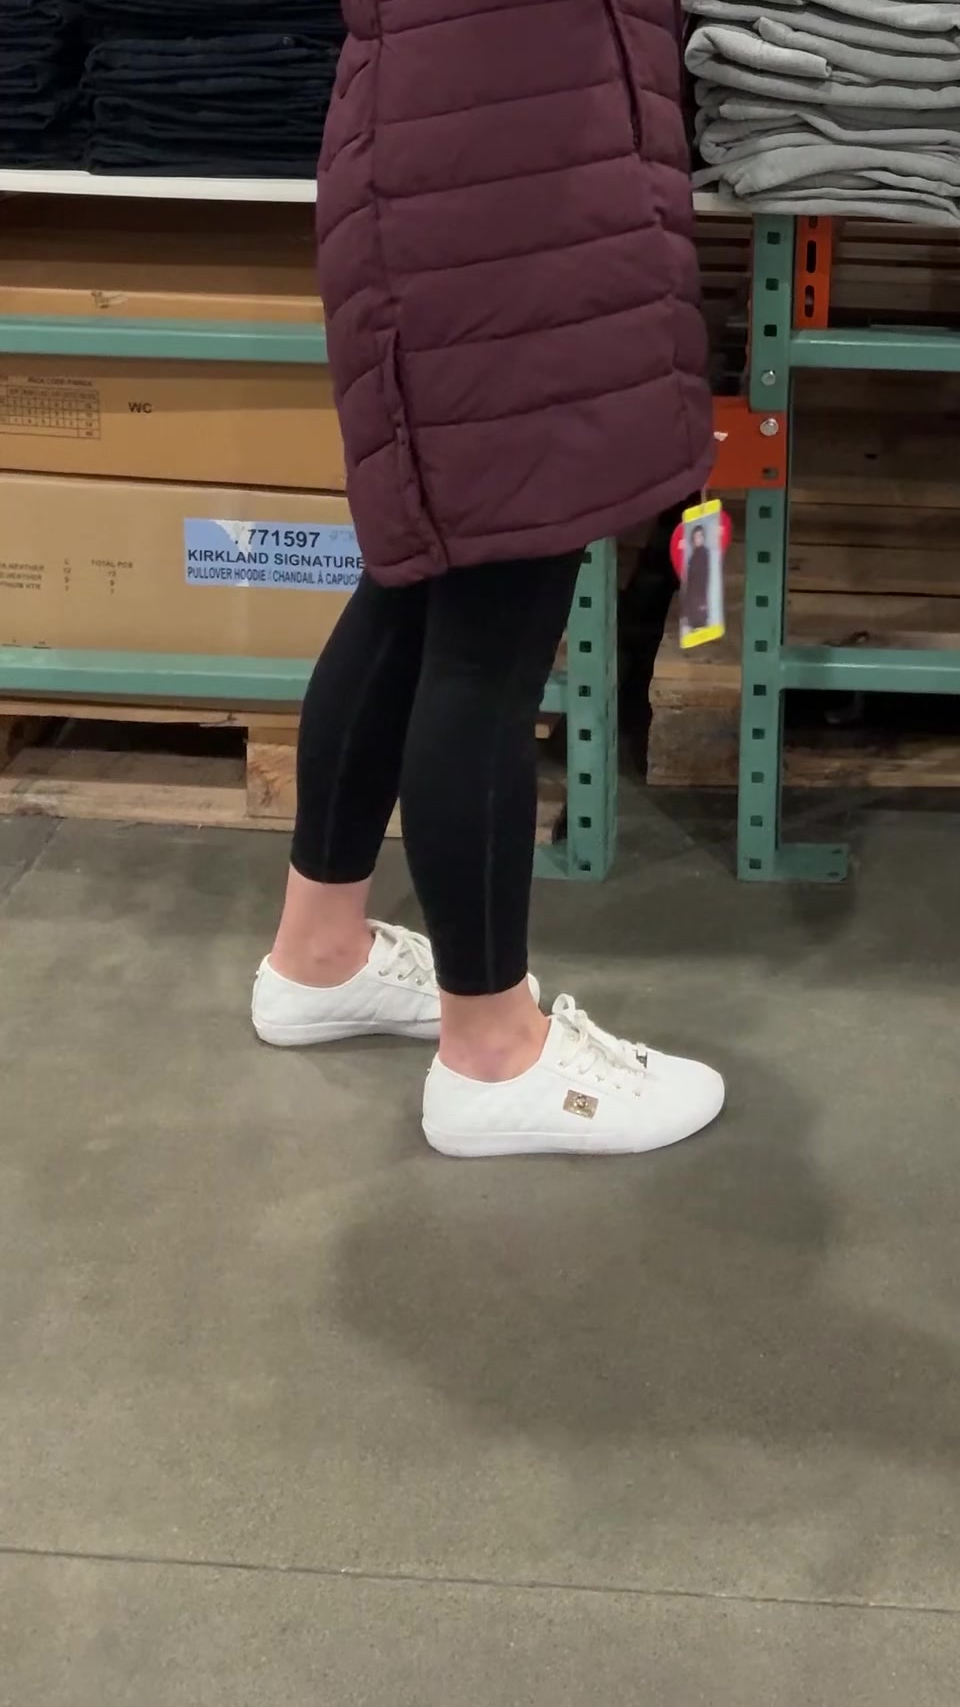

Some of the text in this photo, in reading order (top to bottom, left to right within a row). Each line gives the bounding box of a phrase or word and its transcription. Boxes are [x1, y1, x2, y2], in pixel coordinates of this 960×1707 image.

[128, 402, 152, 414] WC
[187, 549, 364, 569] KIRKLAND SIGNATURE
[187, 566, 232, 580] PULLOVER
[234, 568, 266, 581] HOODIE
[272, 569, 315, 583] CHANDAIL
